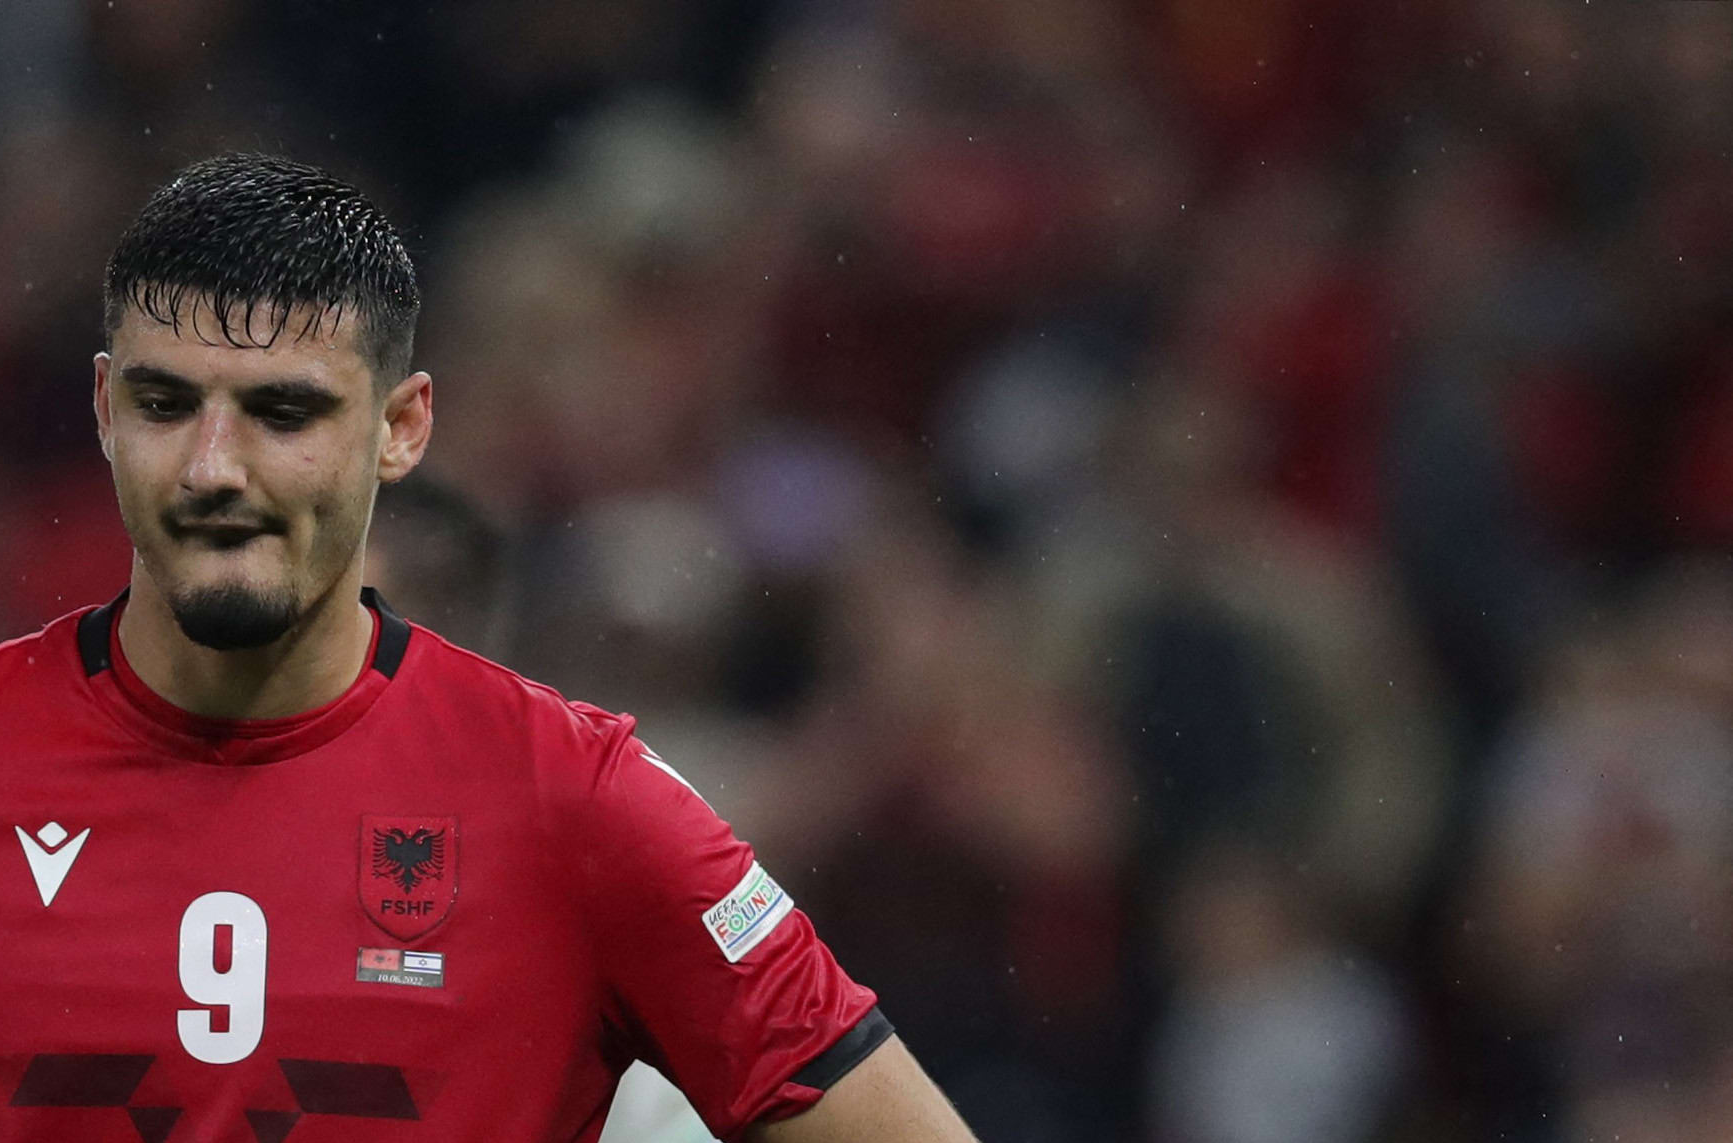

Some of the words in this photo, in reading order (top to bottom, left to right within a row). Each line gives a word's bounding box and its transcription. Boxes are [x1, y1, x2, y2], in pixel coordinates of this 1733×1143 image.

[381, 899, 435, 915] FSHF
[708, 897, 738, 926] UEFA
[177, 891, 268, 1065] 9
